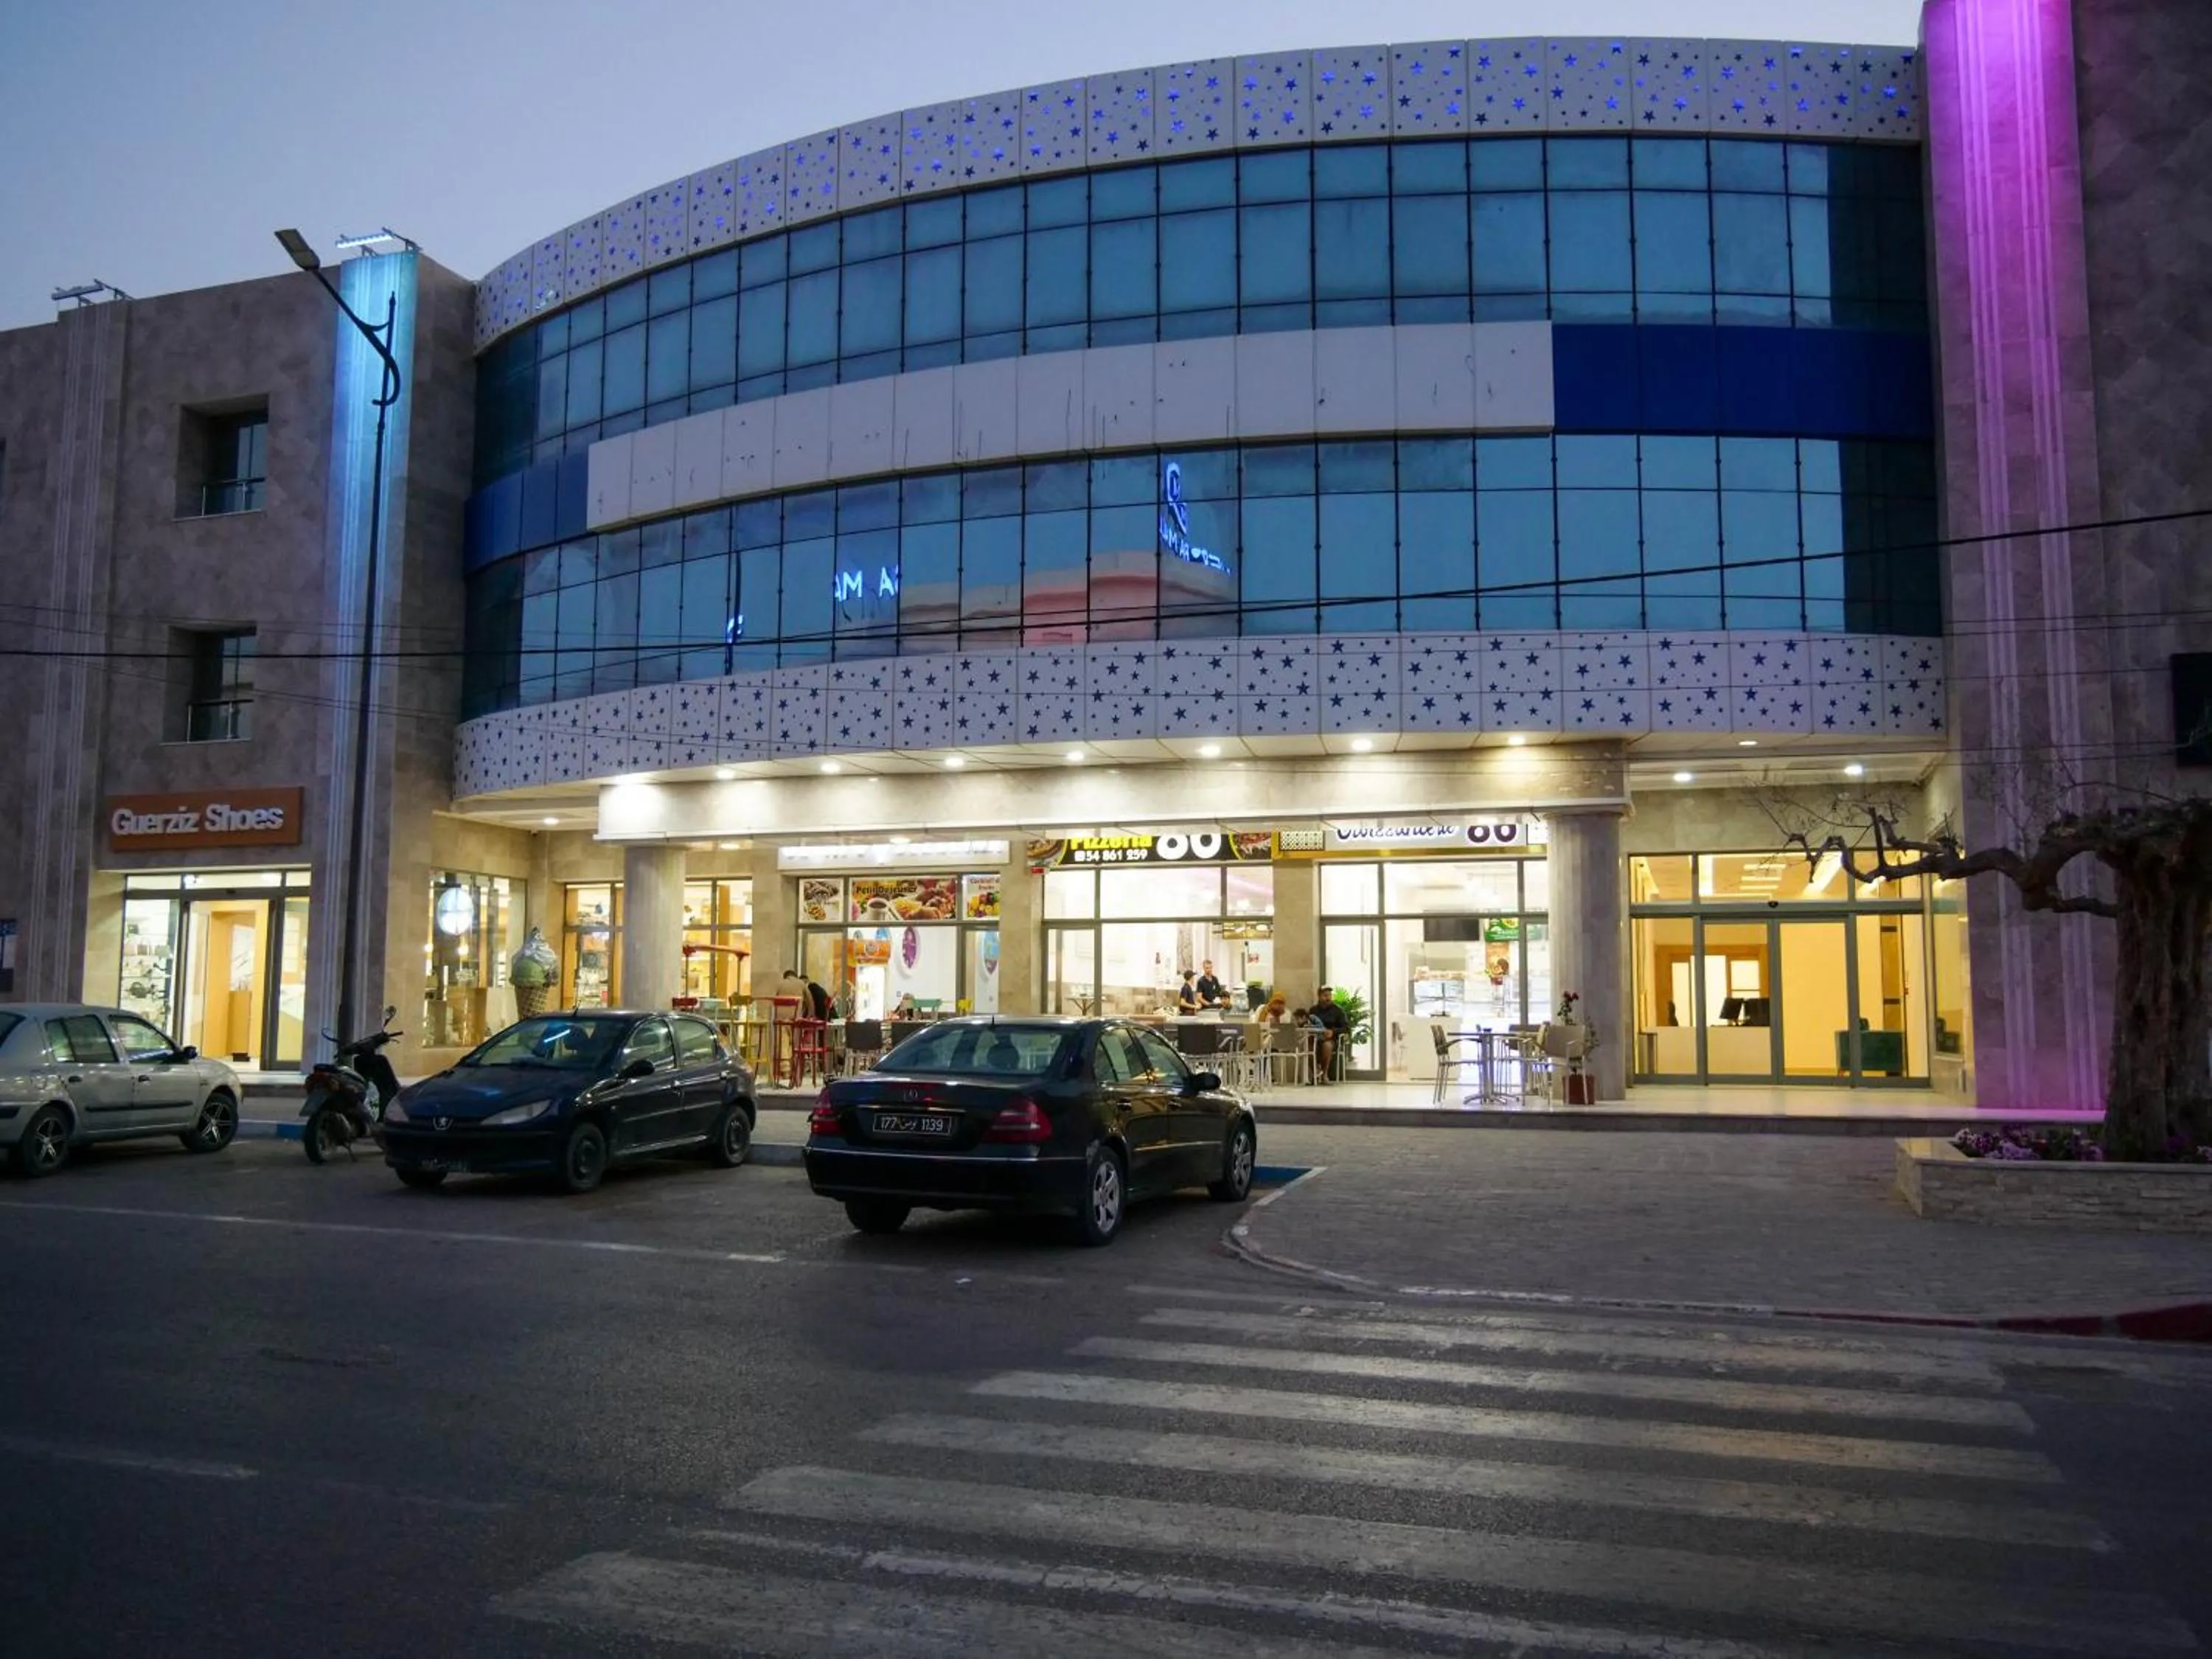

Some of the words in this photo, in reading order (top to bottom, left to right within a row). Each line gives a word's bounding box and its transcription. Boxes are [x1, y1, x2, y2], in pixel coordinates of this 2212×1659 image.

[112, 807, 200, 835] Guerziz
[205, 804, 283, 832] Shoes
[881, 1116, 897, 1130] 177
